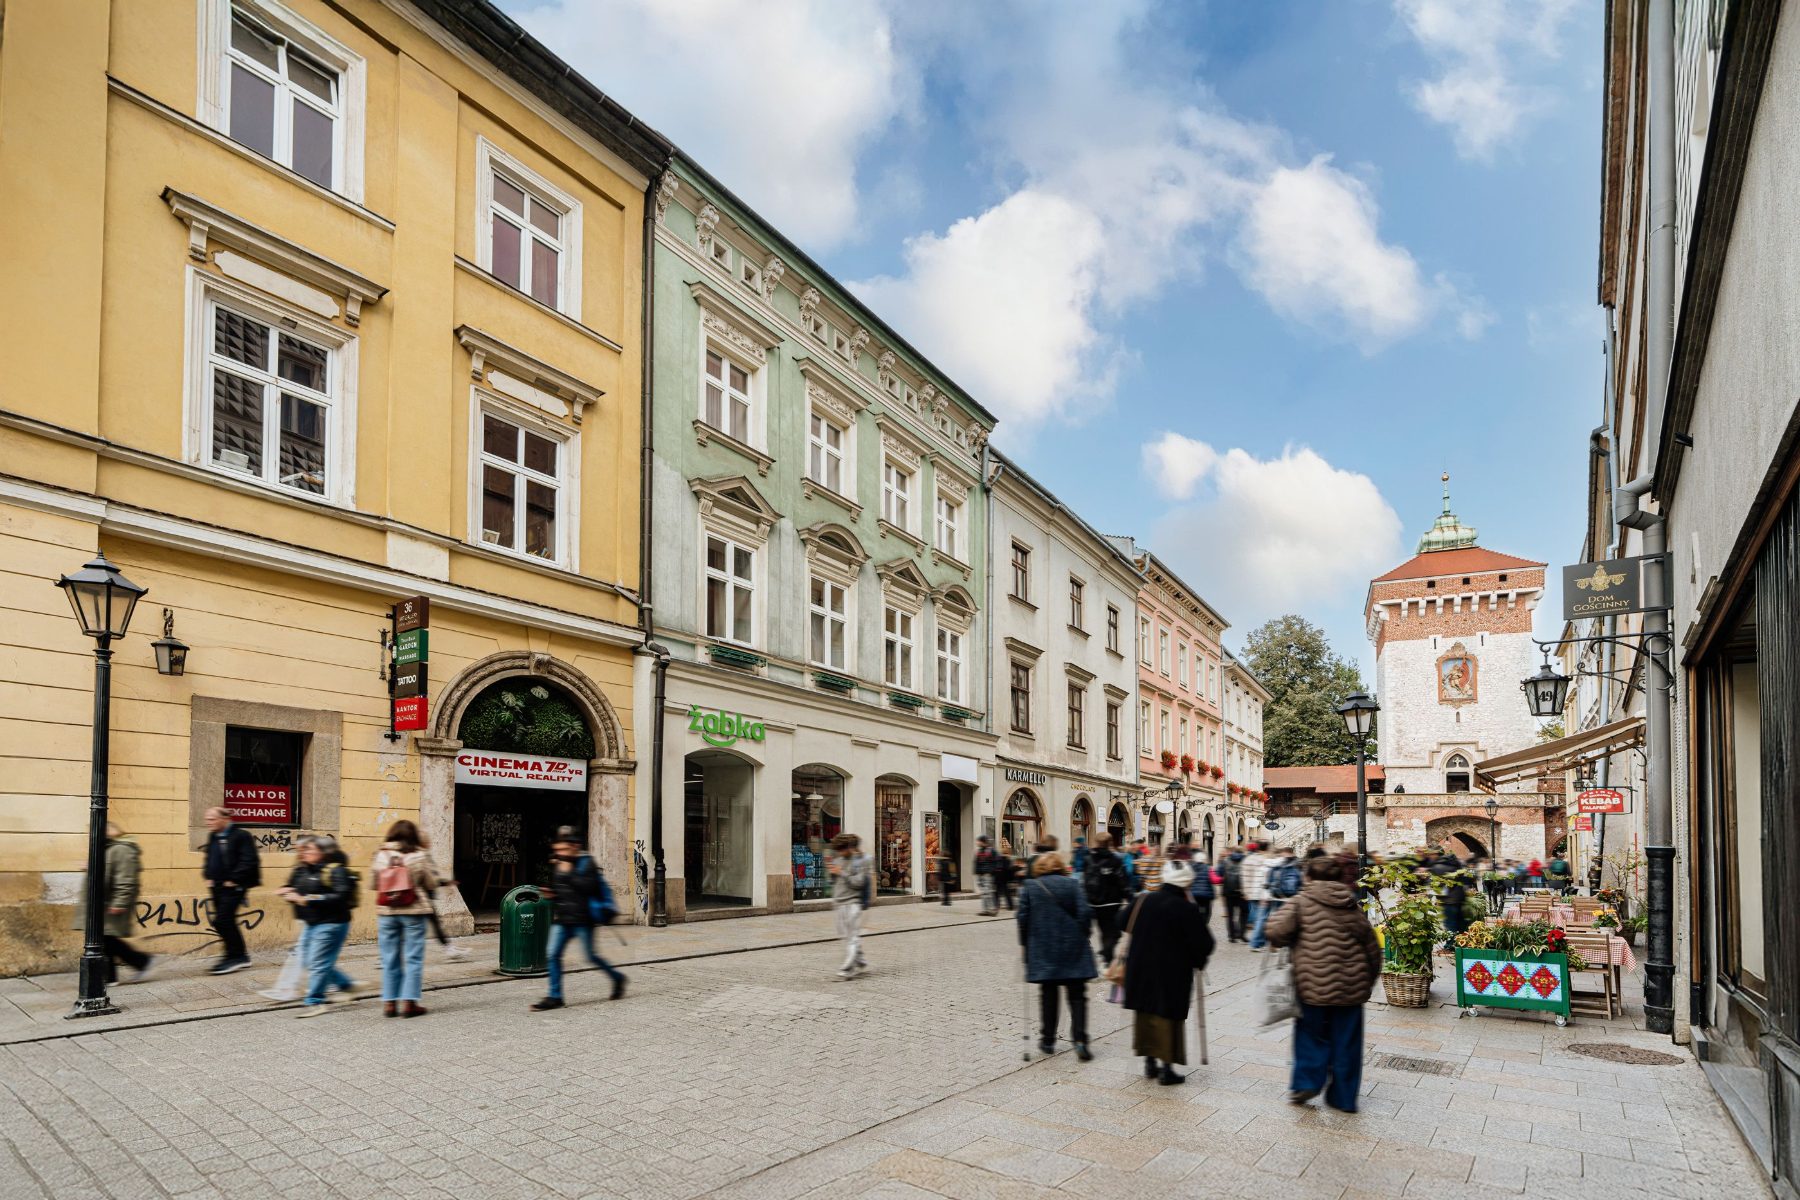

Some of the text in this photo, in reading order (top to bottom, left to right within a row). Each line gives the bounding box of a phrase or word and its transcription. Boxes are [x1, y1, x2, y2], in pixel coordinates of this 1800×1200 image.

[1588, 594, 1614, 603] DOM
[404, 602, 413, 614] 36
[1573, 600, 1630, 612] GOŚCINNY
[397, 674, 417, 686] TATTOO
[1539, 690, 1553, 702] 49
[396, 704, 418, 713] KANTOR
[457, 755, 543, 772] CINEMA
[568, 768, 583, 776] VR
[469, 768, 573, 783] VIRTUAL REALITY
[1006, 768, 1047, 785] KARMELLO
[225, 789, 286, 800] KANTOR
[1580, 797, 1621, 805] KEBAB
